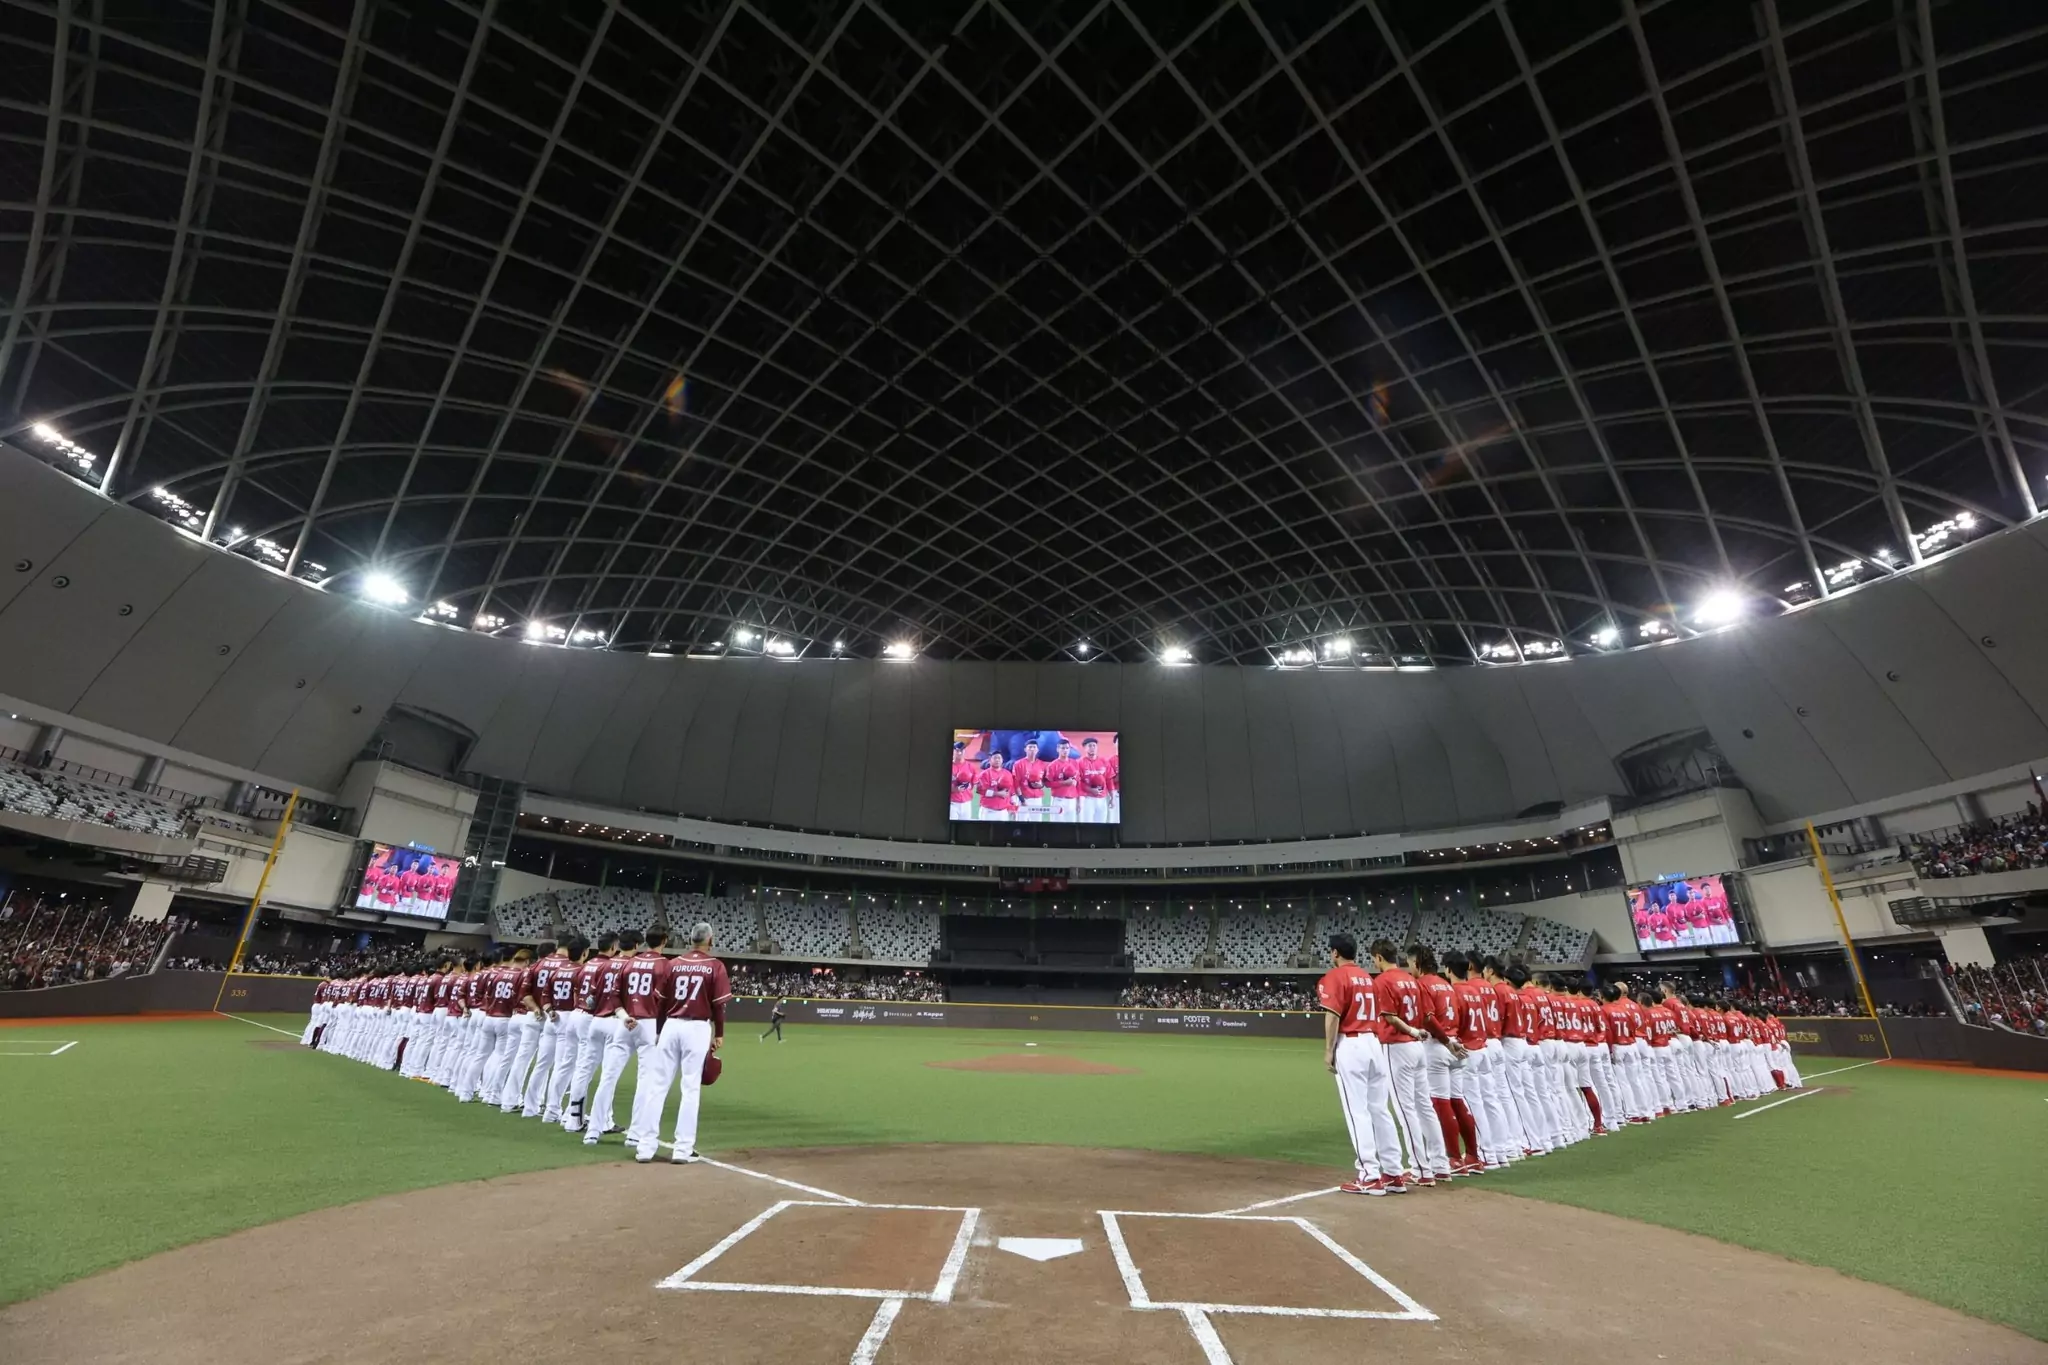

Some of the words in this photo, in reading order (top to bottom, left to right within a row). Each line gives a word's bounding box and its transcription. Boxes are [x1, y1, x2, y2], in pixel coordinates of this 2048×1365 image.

[672, 965, 712, 975] FURUKUBO
[495, 981, 513, 999] 86
[553, 981, 572, 1000] 58
[628, 972, 652, 996] 98
[674, 975, 704, 1001] 87
[1355, 992, 1377, 1021] 27
[1183, 1015, 1211, 1023] FOOTER
[1614, 1021, 1629, 1037] 76
[1858, 1033, 1876, 1042] 335
